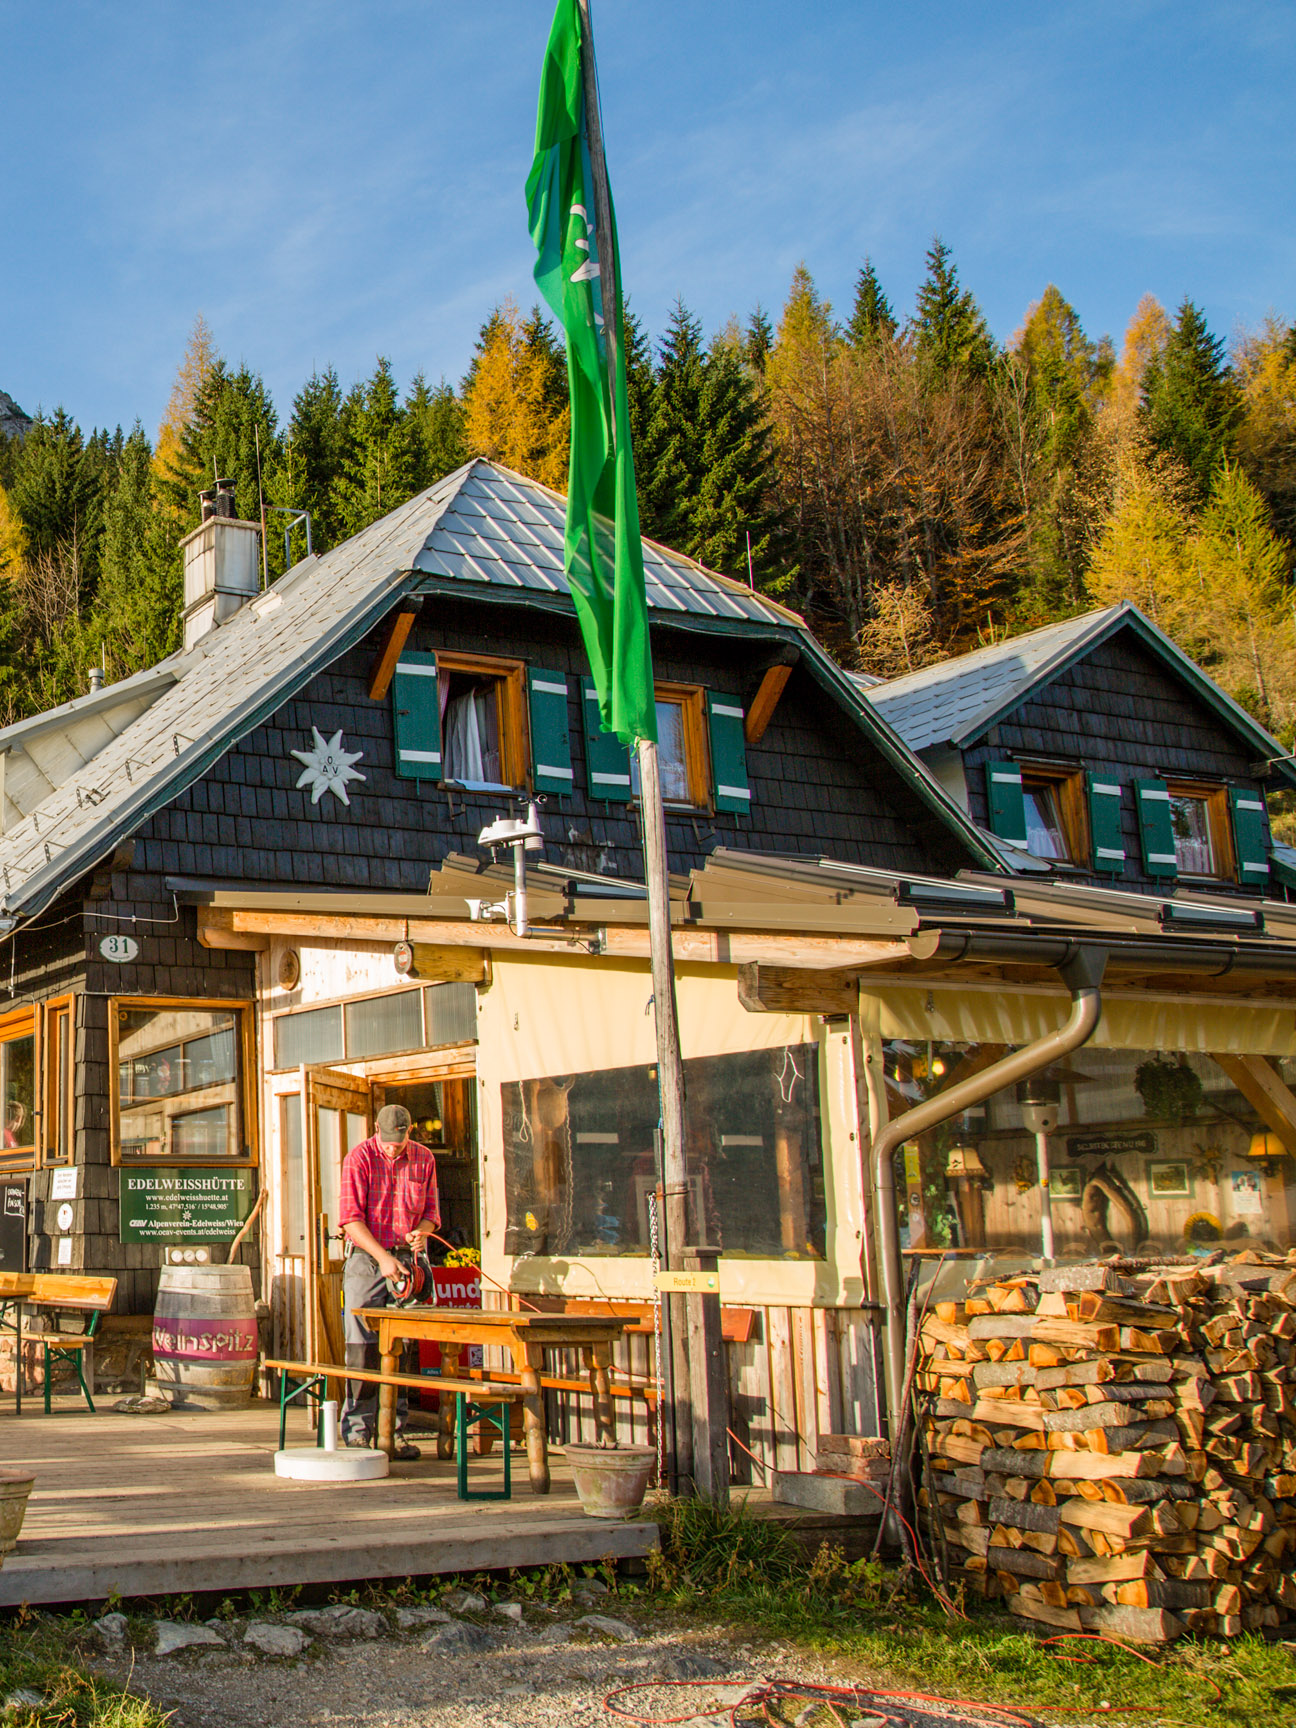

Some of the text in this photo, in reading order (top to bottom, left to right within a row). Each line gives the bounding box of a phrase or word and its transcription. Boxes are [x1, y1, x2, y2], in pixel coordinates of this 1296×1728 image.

[109, 937, 129, 954] 31
[128, 1176, 245, 1190] EDELWEISSHÜTTE
[148, 1220, 244, 1229] Alpenverein-Edelweiss/Wien
[139, 1228, 236, 1236] www.oeav-events.at/edelweiss
[673, 1277, 691, 1287] Route
